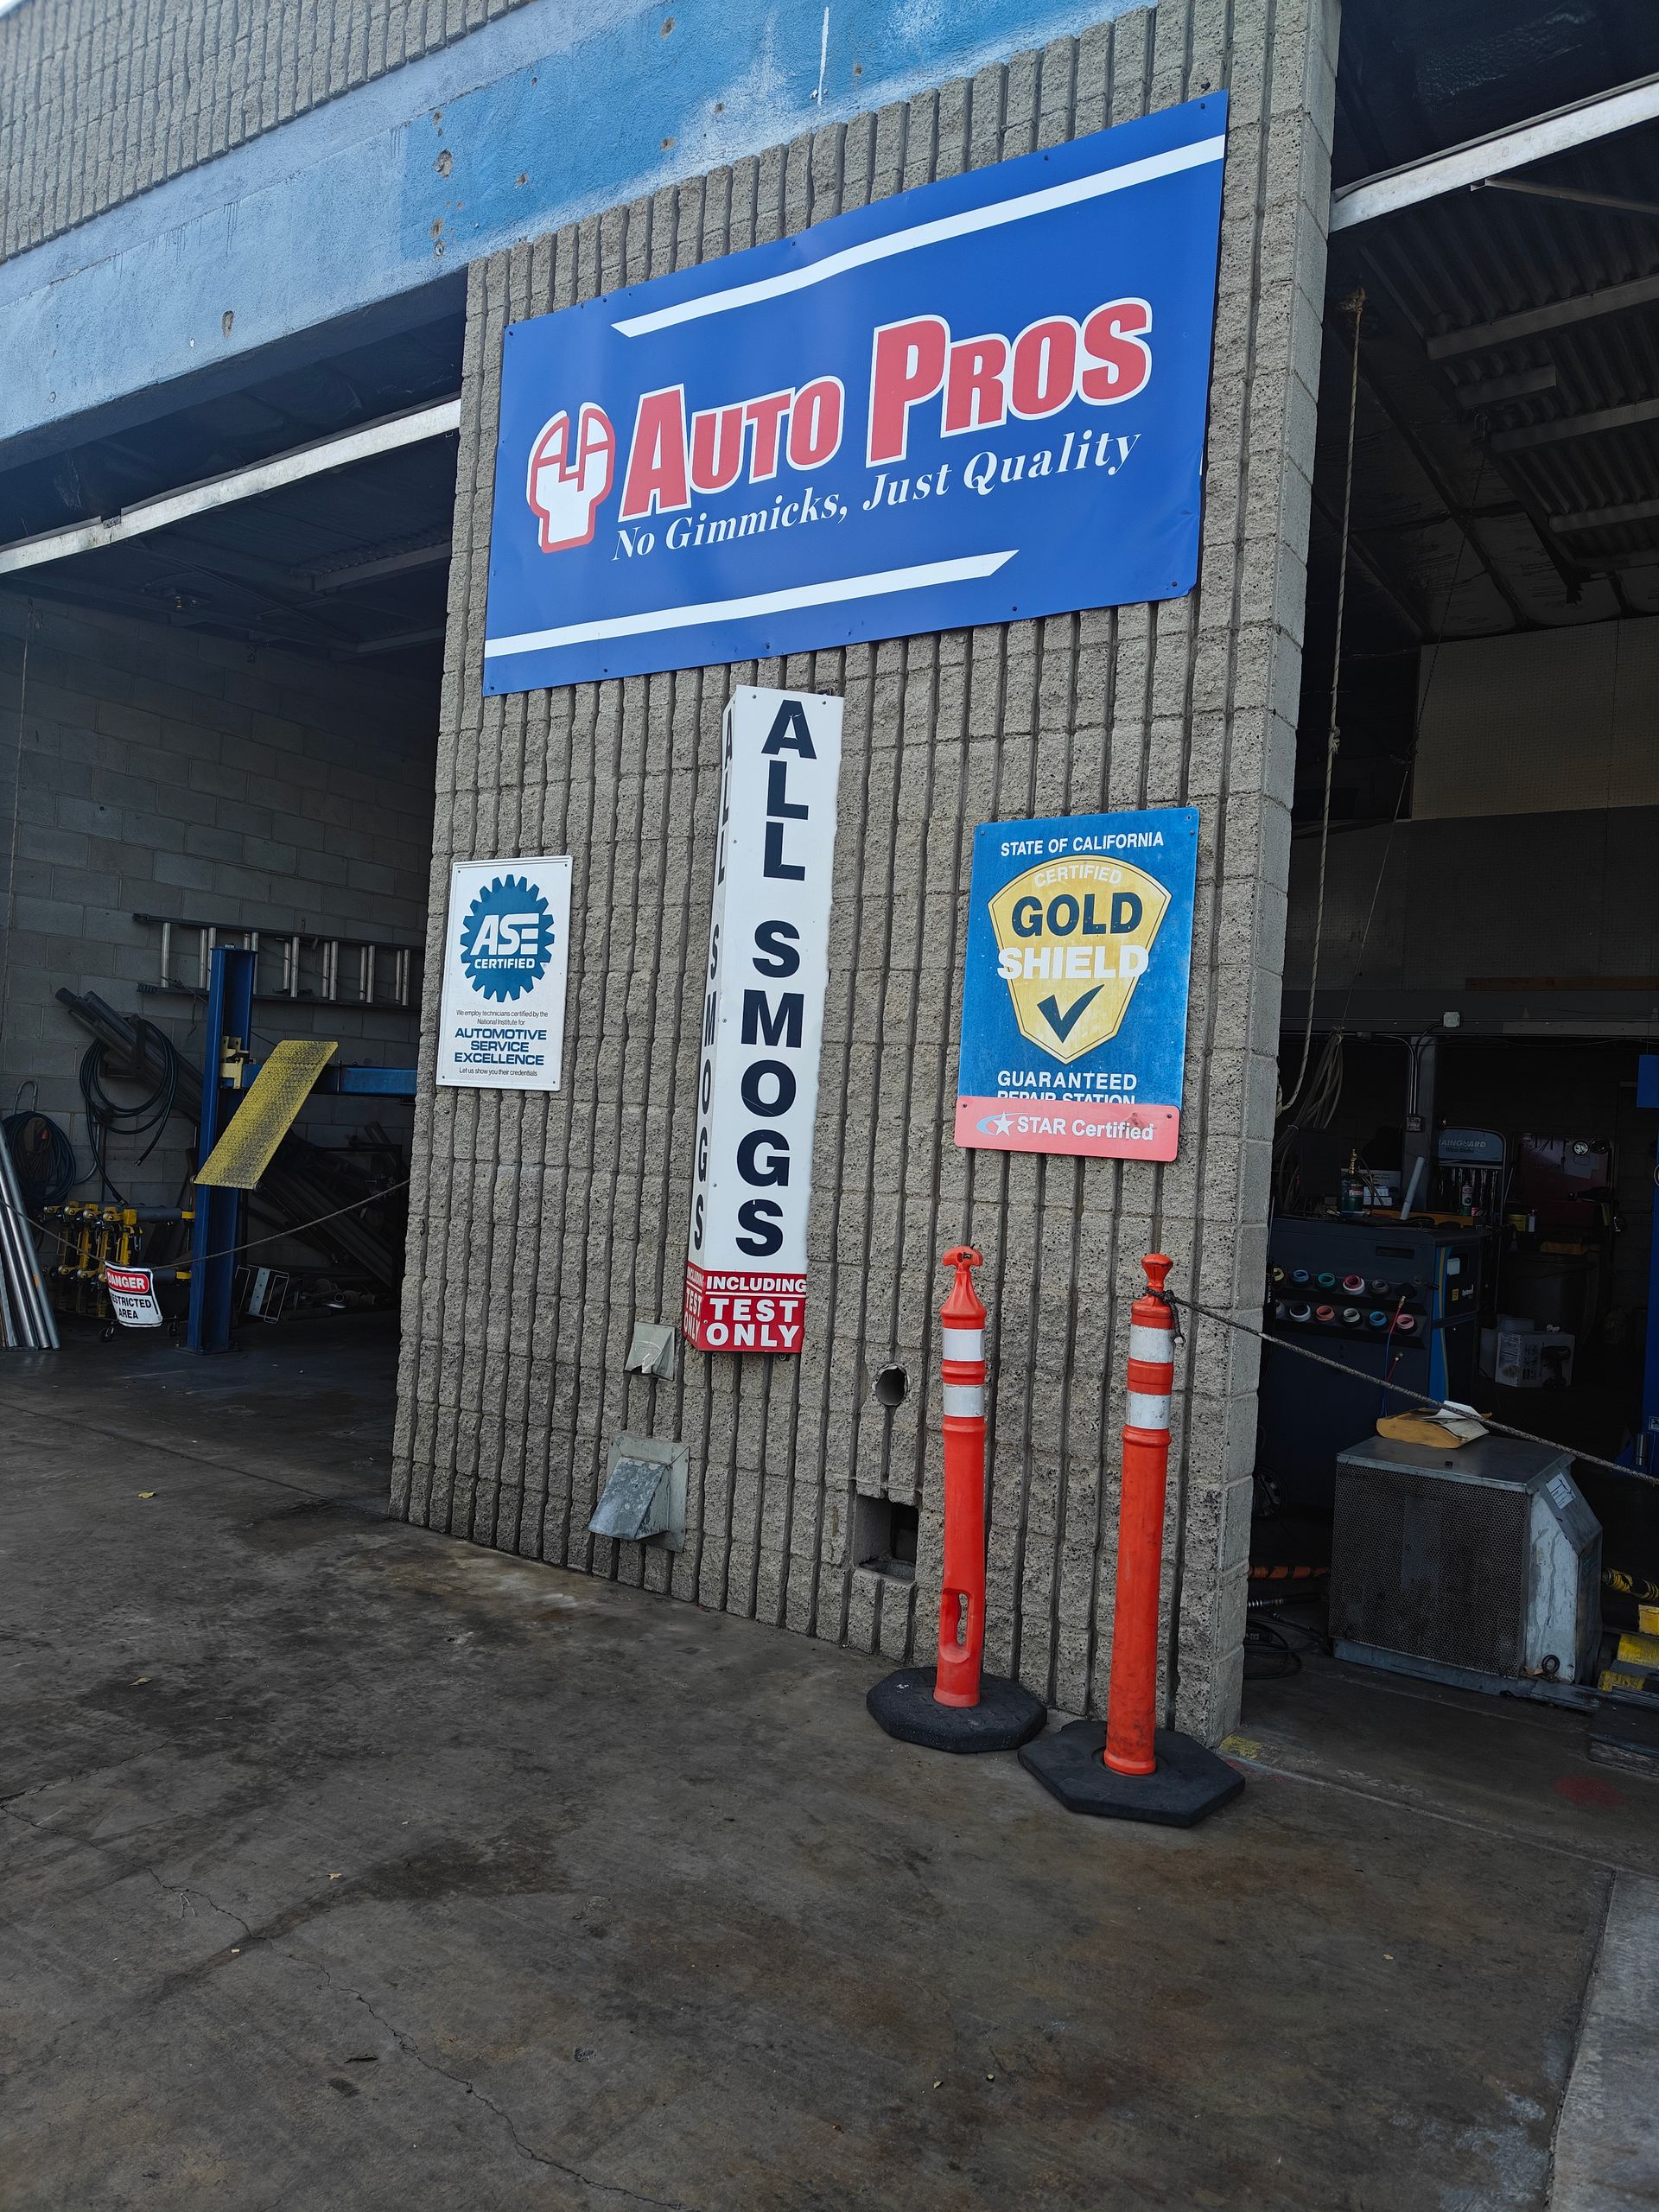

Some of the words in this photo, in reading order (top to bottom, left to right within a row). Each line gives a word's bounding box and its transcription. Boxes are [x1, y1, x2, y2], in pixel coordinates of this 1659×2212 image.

[618, 376, 845, 523] AUTO
[866, 297, 1153, 468] PROS
[611, 526, 655, 561] No
[665, 486, 848, 550] Gimmicks,
[862, 463, 952, 511] Just
[963, 429, 1143, 495] Quality
[761, 699, 817, 881] ALL
[1001, 840, 1043, 856] STATE
[1048, 838, 1068, 853] OF
[1072, 831, 1164, 850] CALIFORNIA
[1033, 864, 1122, 887] CERTIFIED
[1011, 891, 1143, 938] GOLD
[469, 913, 540, 956] ASE
[474, 958, 536, 969] CERTIFIED
[997, 944, 1149, 980] SHIELD
[464, 1009, 481, 1018] employ
[454, 1027, 547, 1040] AUTOMOTIVE
[470, 1040, 530, 1052] SERVICE
[454, 1052, 544, 1065] EXCELLENCE
[735, 920, 804, 1257] SMOGS
[997, 1070, 1137, 1090] GUARANTEED
[1017, 1116, 1067, 1135] STAR
[1071, 1120, 1154, 1141] Certified
[107, 1272, 146, 1289] DANGER
[706, 1275, 807, 1292] INCLUDING
[118, 1308, 138, 1319] AREA
[686, 1287, 702, 1318] TEST
[709, 1298, 798, 1323] TEST
[684, 1311, 701, 1343] ONLY
[706, 1322, 799, 1348] ONLY
